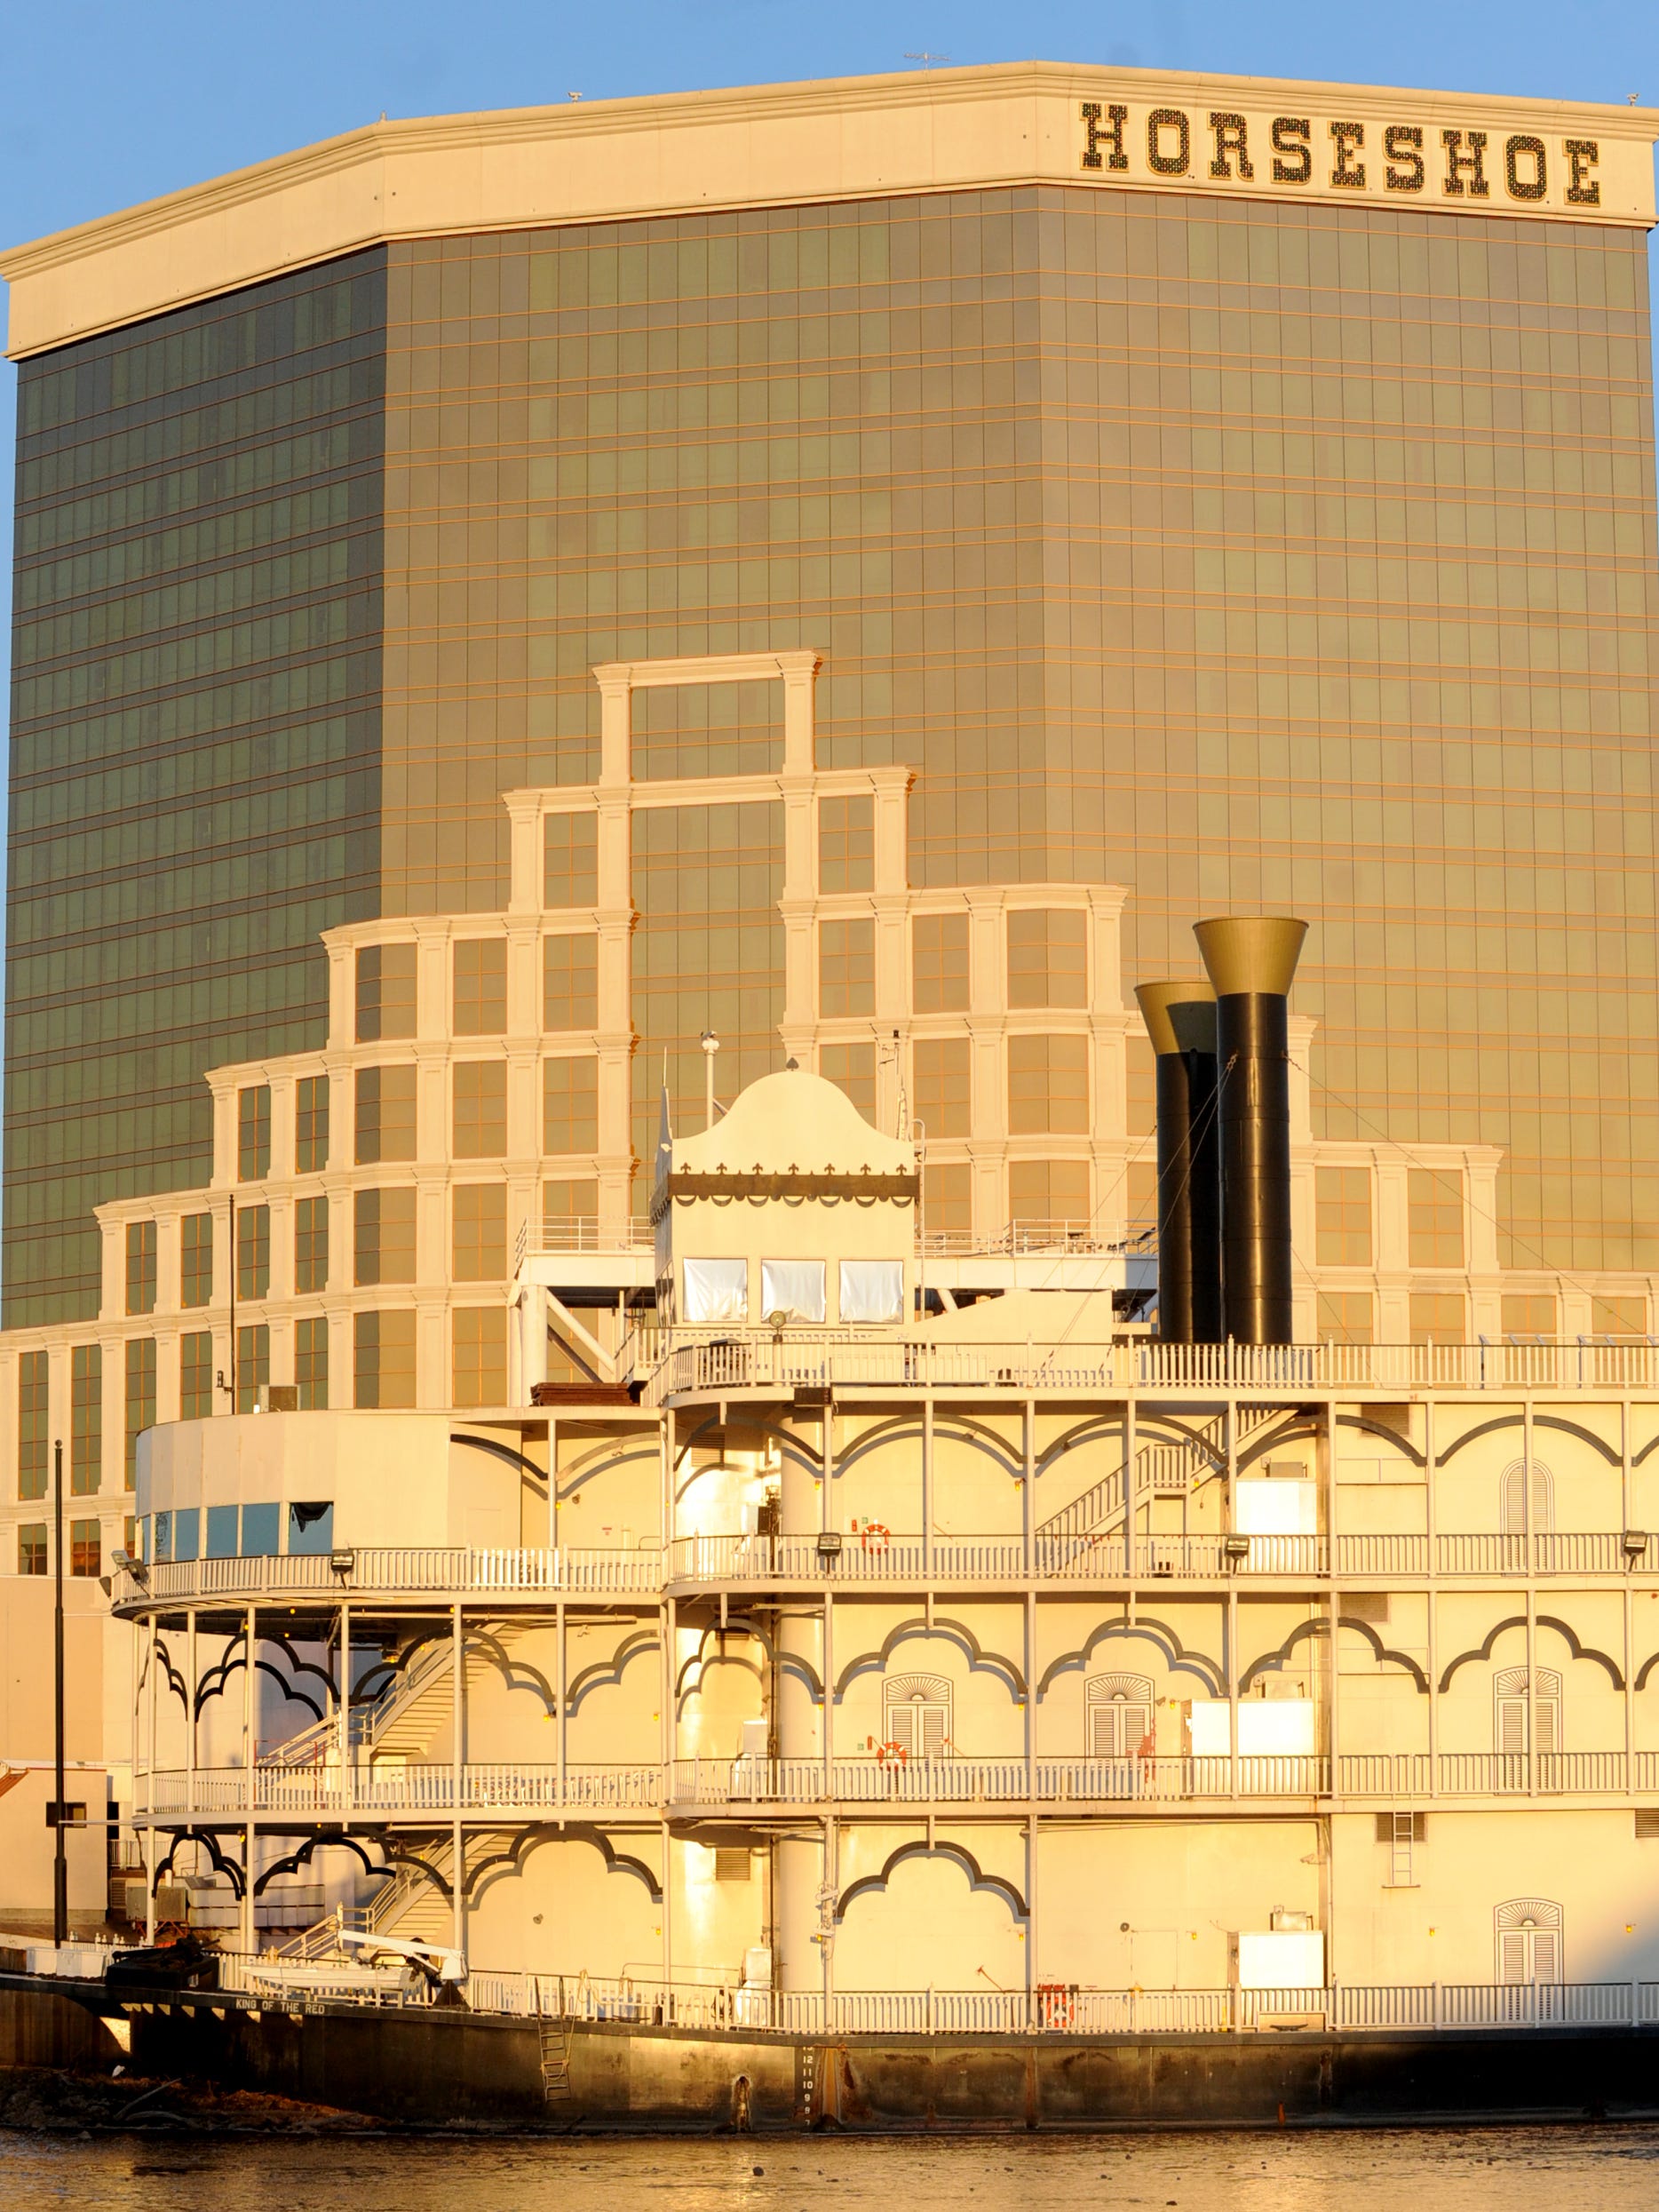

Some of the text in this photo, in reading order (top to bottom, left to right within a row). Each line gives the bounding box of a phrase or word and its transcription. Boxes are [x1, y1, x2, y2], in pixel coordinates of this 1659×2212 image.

[1079, 101, 1602, 207] HORSESHOE
[235, 1998, 325, 2015] KING OF THE RED
[803, 2068, 812, 2077] 11
[803, 2081, 814, 2089] 10
[804, 2093, 811, 2102] 9
